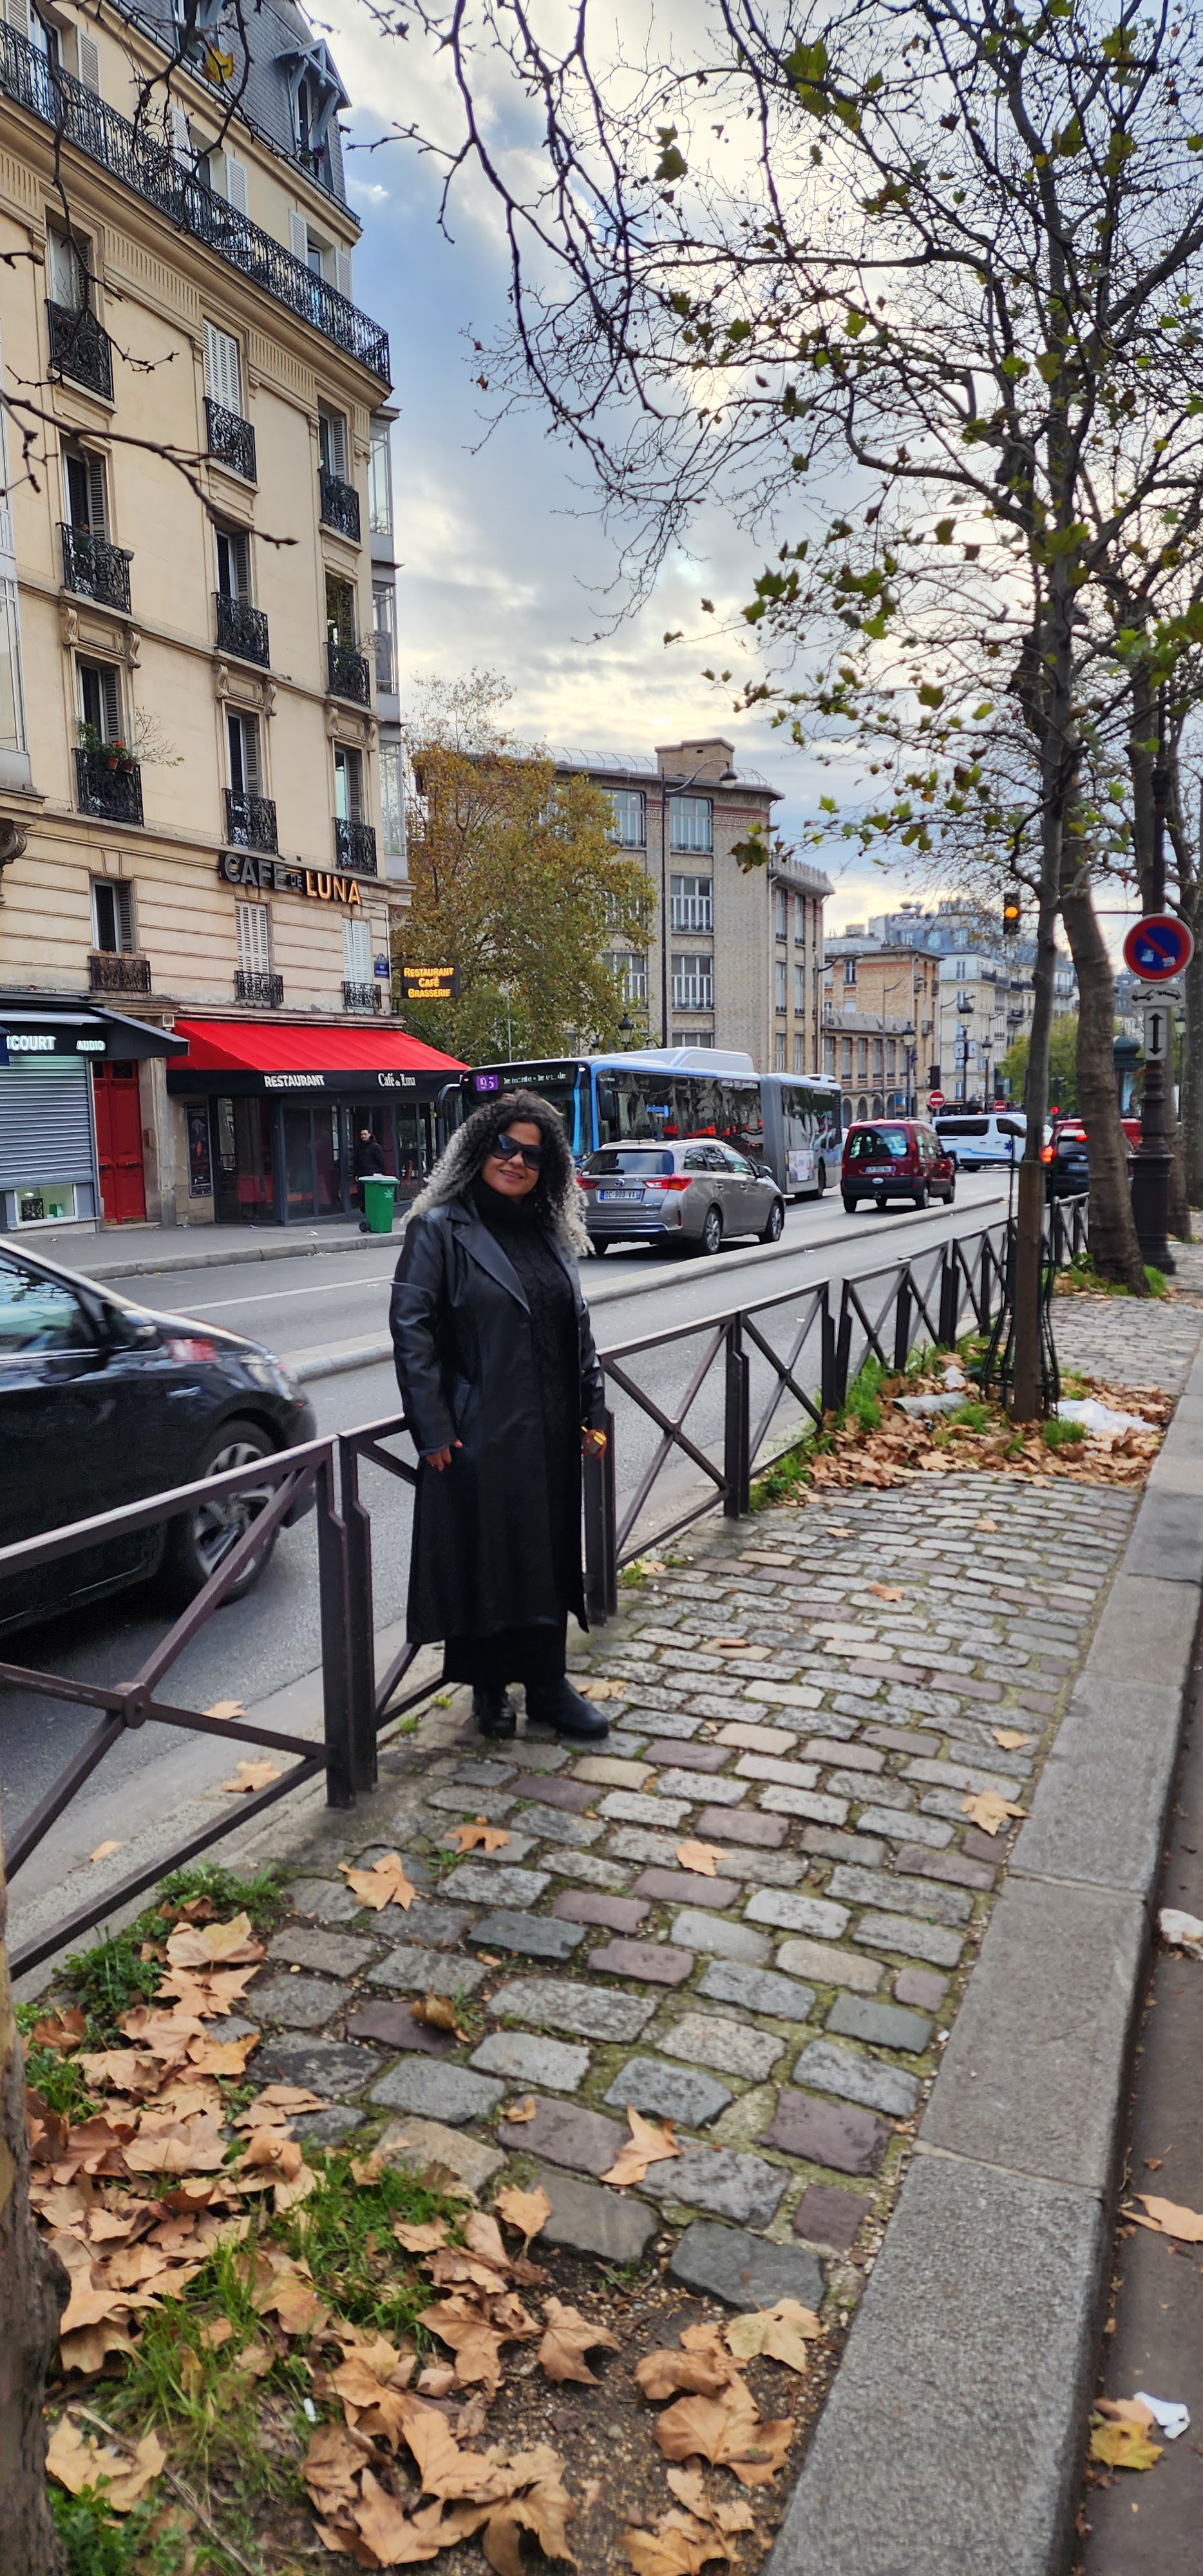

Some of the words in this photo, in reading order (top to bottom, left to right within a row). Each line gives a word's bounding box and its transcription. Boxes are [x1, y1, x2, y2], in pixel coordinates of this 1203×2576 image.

[290, 874, 303, 887] DE
[305, 870, 363, 905] LUNA
[404, 967, 455, 978] RESTAURANT
[408, 988, 451, 998] BRASSERIE
[76, 1040, 106, 1051] AUDIO
[264, 1075, 325, 1087] RESTAURANT
[377, 1072, 395, 1086] Café
